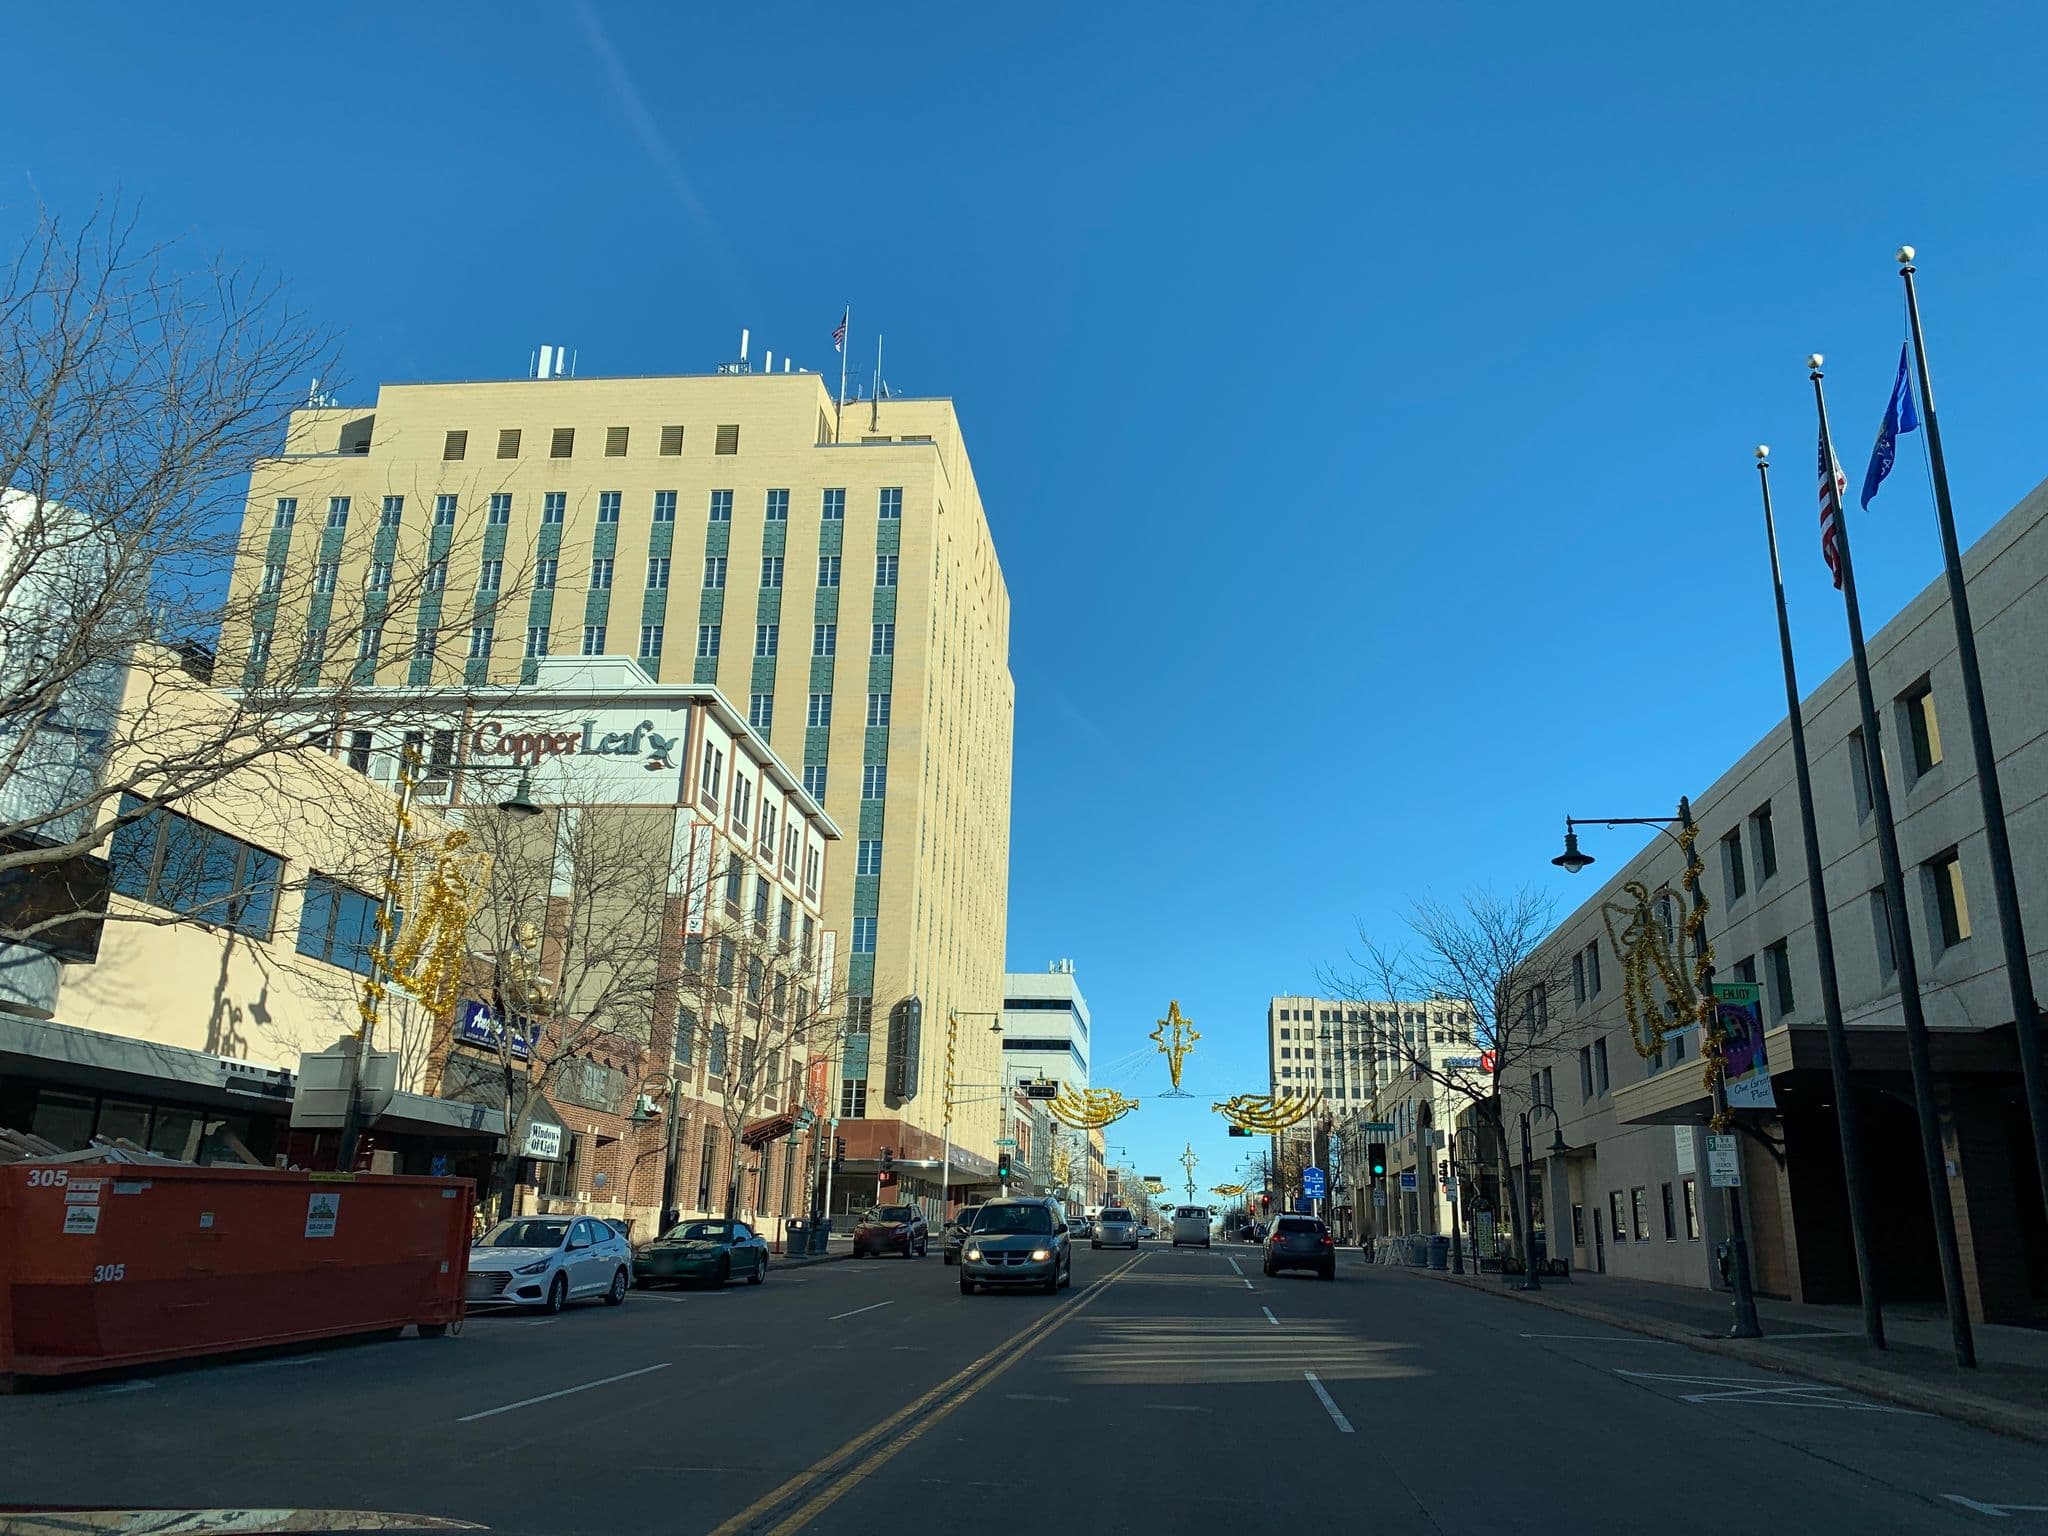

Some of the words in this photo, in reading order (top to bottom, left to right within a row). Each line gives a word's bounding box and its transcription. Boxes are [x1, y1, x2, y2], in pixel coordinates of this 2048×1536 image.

[1722, 988, 1750, 1000] ENJOY
[532, 1125, 560, 1141] Windows
[531, 1139, 539, 1151] Of
[540, 1140, 557, 1154] Light
[27, 1169, 68, 1187] 305
[94, 1264, 125, 1283] 305
